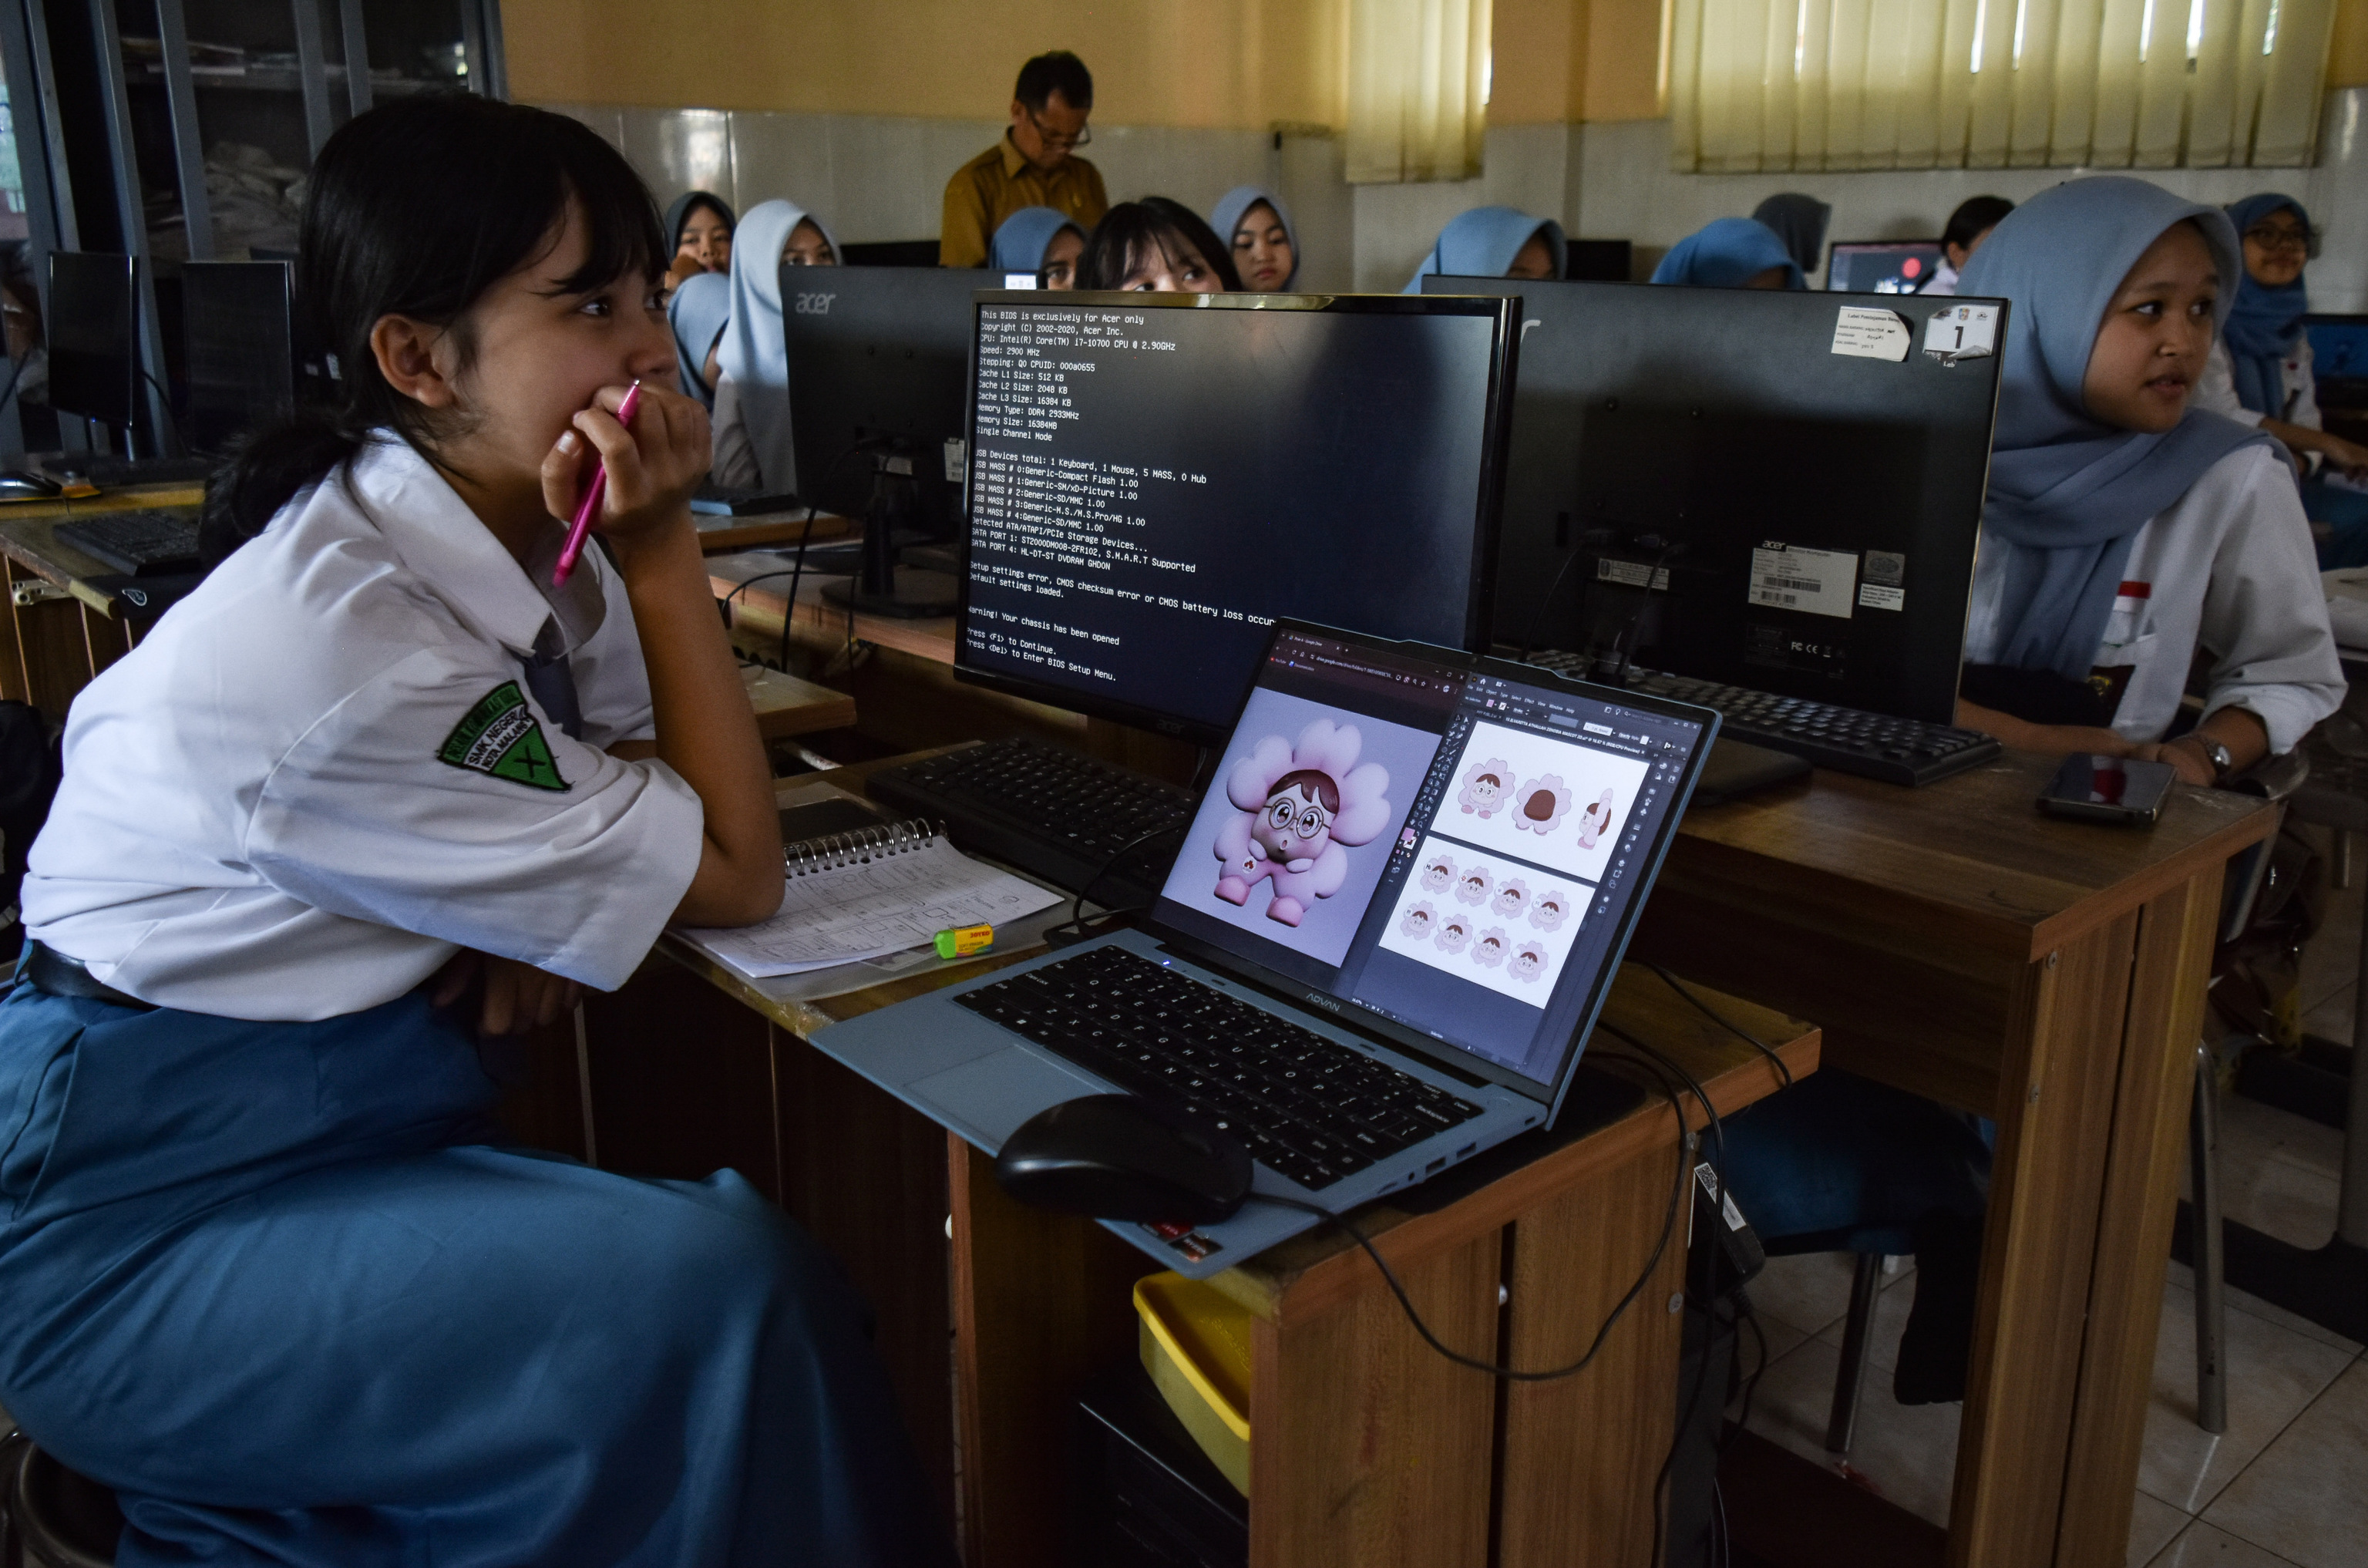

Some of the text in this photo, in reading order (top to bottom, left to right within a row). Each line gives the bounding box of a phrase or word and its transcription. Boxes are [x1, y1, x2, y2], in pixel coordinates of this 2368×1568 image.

[796, 293, 836, 315] acer
[982, 311, 997, 319] This
[1021, 311, 1029, 320] is
[1033, 312, 1081, 323] exclusively
[1085, 313, 1098, 322] for
[1102, 315, 1121, 323] Acer
[1125, 315, 1144, 325] only
[1021, 323, 1032, 332] (C)
[1036, 325, 1078, 335] 2002-2020,
[1084, 326, 1102, 335] Acer
[1106, 327, 1123, 335] Inc.
[1955, 326, 1964, 349] 1
[980, 345, 1002, 355] Speed:
[1007, 347, 1024, 355] 2900
[1000, 335, 1031, 345] Intel(R)
[1036, 336, 1069, 346] Core(TM)
[1114, 339, 1128, 348] CPU
[1132, 341, 1138, 349] @
[1142, 341, 1176, 351] 2.90GHz
[980, 357, 1014, 368] Stepping:
[1018, 359, 1027, 368] Q0
[1031, 360, 1055, 369] CPUID:
[1001, 370, 1010, 379] L1
[1014, 371, 1034, 380] Size:
[1038, 372, 1051, 381] 512
[1001, 382, 1010, 390] L2
[1013, 382, 1033, 392] Size:
[1038, 384, 1055, 393] 2048
[1012, 394, 1032, 403] Size:
[1038, 396, 1058, 405] 16384
[1062, 399, 1071, 407] KB
[1004, 405, 1024, 415] Type:
[1028, 407, 1044, 416] DDR4
[1049, 409, 1079, 419] 2933MHz
[977, 426, 1052, 441] Single Channel Mode
[1004, 417, 1023, 426] Size:
[1028, 419, 1057, 429] 16384MB
[990, 450, 1018, 461] Devices
[1022, 454, 1046, 464] total:
[1059, 459, 1097, 472] Keyboard,
[1103, 463, 1107, 472] 1
[1111, 465, 1138, 476] Mouse,
[1143, 468, 1149, 476] 5
[1152, 469, 1176, 481] MASS,
[1182, 473, 1187, 481] 0
[1191, 474, 1206, 483] Hub
[990, 462, 1005, 471] MASS
[1092, 474, 1115, 485] Flash
[1120, 478, 1139, 488] 1.00
[988, 485, 1004, 494] MASS
[1088, 499, 1105, 508] 1.00
[989, 473, 1005, 483] MASS
[1119, 490, 1138, 500] 1.00
[987, 507, 1004, 516] MASS
[1086, 523, 1104, 533] 1.00
[988, 496, 1004, 506] MASS
[1127, 516, 1145, 527] 1.00
[973, 528, 987, 537] SATA
[990, 530, 1007, 540] PORT
[1106, 550, 1148, 564] S.M.A.R.T
[1152, 557, 1196, 573] Supported
[1068, 531, 1098, 544] Storage
[1102, 537, 1147, 552] Devices...
[1762, 540, 1786, 550] acer
[972, 539, 986, 548] SATA
[990, 542, 1006, 551] PORT
[1021, 547, 1054, 560] HL-DT-ST
[1058, 554, 1084, 566] DVDRAM
[971, 561, 989, 572] Setup
[992, 567, 1024, 578] settings
[1028, 573, 1051, 584] error,
[1057, 577, 1074, 587] CMOS
[1078, 581, 1114, 595] checksum
[1117, 590, 1140, 600] error
[1159, 597, 1179, 607] CMOS
[1182, 601, 1218, 617] battery
[1223, 609, 1243, 621] loss
[1248, 615, 1276, 626] occur
[1000, 579, 1031, 591] settings
[1036, 585, 1064, 597] loaded.
[1001, 613, 1018, 622] Your
[1021, 617, 1050, 630] chassis
[1054, 624, 1067, 634] has
[1071, 627, 1088, 638] been
[1092, 634, 1119, 645] opened
[990, 633, 1004, 642] <F1>
[1008, 637, 1017, 645] to
[1020, 640, 1056, 654] Continue.
[989, 644, 1007, 654] <Del>
[1012, 649, 1020, 658] to
[1024, 651, 1044, 663] Enter
[1048, 658, 1065, 668] BIOS
[1068, 663, 1091, 675] Setup
[1095, 669, 1115, 681] Menu.
[1549, 703, 1564, 712] Window
[469, 738, 489, 765] SMK
[1306, 992, 1340, 1012] ADVAN
